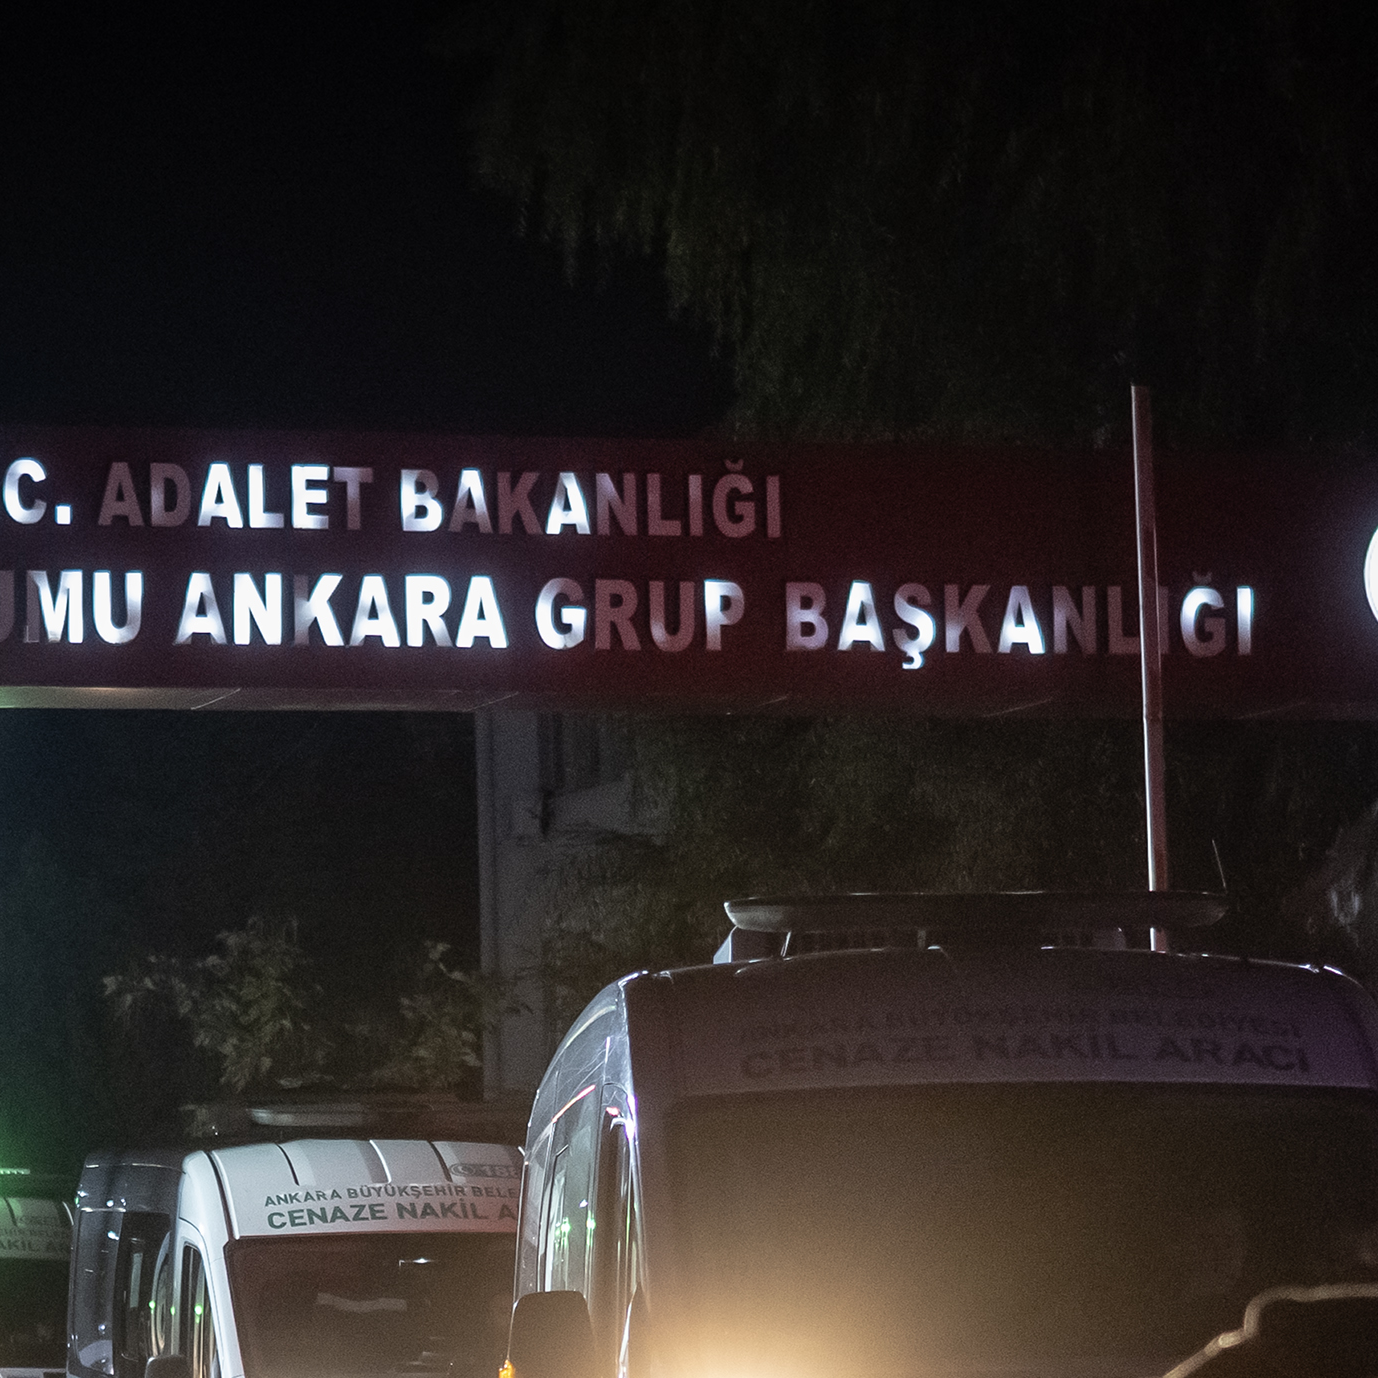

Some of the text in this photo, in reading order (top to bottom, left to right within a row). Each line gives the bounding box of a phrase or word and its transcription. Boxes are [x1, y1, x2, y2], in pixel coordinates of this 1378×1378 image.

[96, 460, 374, 531] ADALET
[399, 459, 782, 539] BAKANLIĞI
[172, 571, 509, 648] ANKARA
[534, 576, 746, 652] GRUP
[740, 1035, 957, 1079] CENAZE
[1153, 1036, 1310, 1073] ARACI
[265, 1190, 342, 1208] ANKARA
[347, 1183, 466, 1200] BÜYÜKŞEHİR
[267, 1197, 519, 1230] CENAZE NAKİL A
